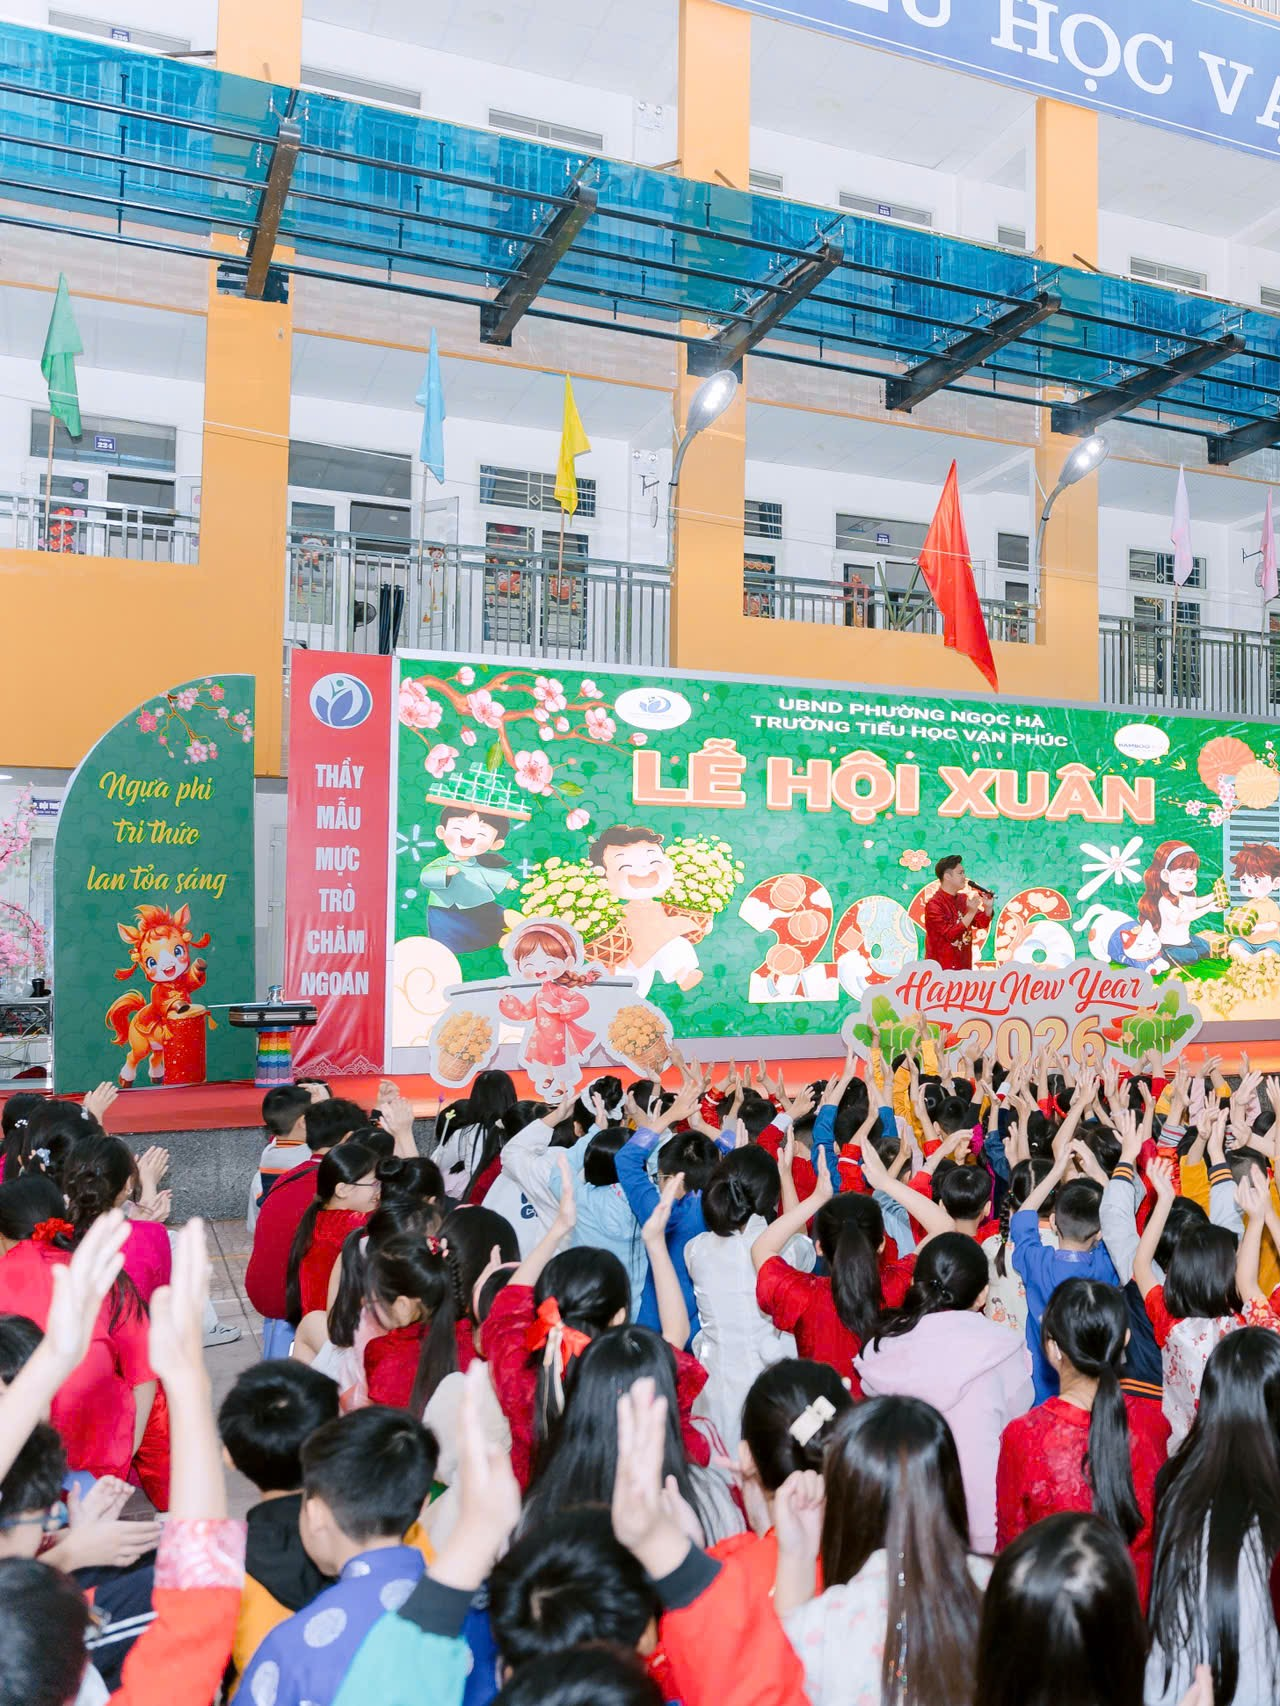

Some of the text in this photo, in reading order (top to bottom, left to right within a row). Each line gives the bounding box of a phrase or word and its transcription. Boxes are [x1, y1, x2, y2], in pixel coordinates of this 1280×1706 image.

[990, 0, 1174, 95] HỌC
[779, 697, 1046, 729] UBND PHƯỜNG NGỌC HÀ
[750, 714, 1069, 748] TRƯỜNG TIỂU HỌC VẠN PHÚC
[99, 771, 216, 808] Ngựa phi
[314, 757, 365, 790] THẦY
[632, 737, 1156, 825] LỄ HỘI XUÂN
[316, 796, 362, 830] MẪU
[111, 817, 201, 845] tri thức
[315, 845, 361, 877] MỰC
[86, 863, 228, 900] lan tỏa sáng
[318, 883, 356, 913] TRÒ
[306, 925, 366, 955] CHĂM
[300, 971, 370, 996] NGOAN
[895, 967, 1157, 1015] Happy New Year
[954, 1014, 1107, 1071] 2026
